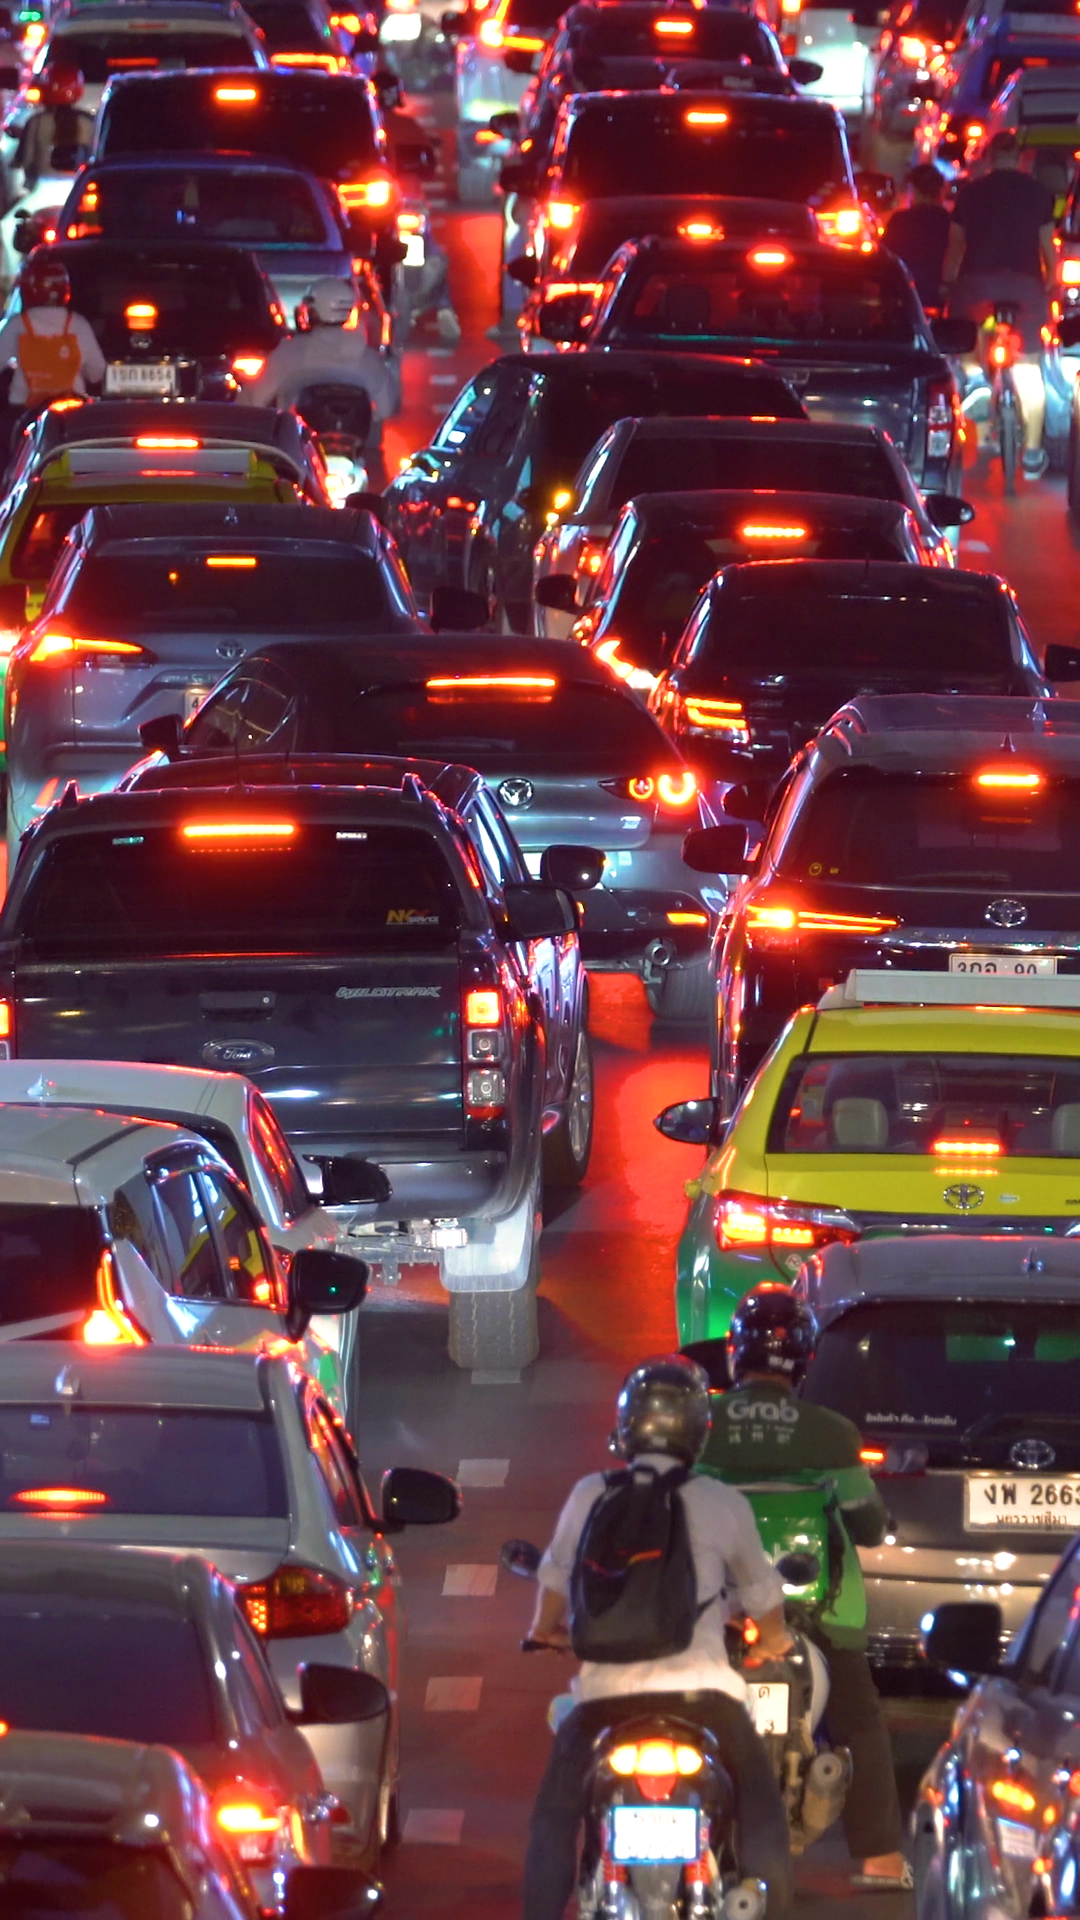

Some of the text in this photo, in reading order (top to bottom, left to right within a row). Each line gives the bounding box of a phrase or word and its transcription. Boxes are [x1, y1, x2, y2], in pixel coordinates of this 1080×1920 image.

[335, 986, 442, 999] WILDTRAK
[223, 1047, 253, 1060] Ford
[727, 1397, 799, 1422] Grab
